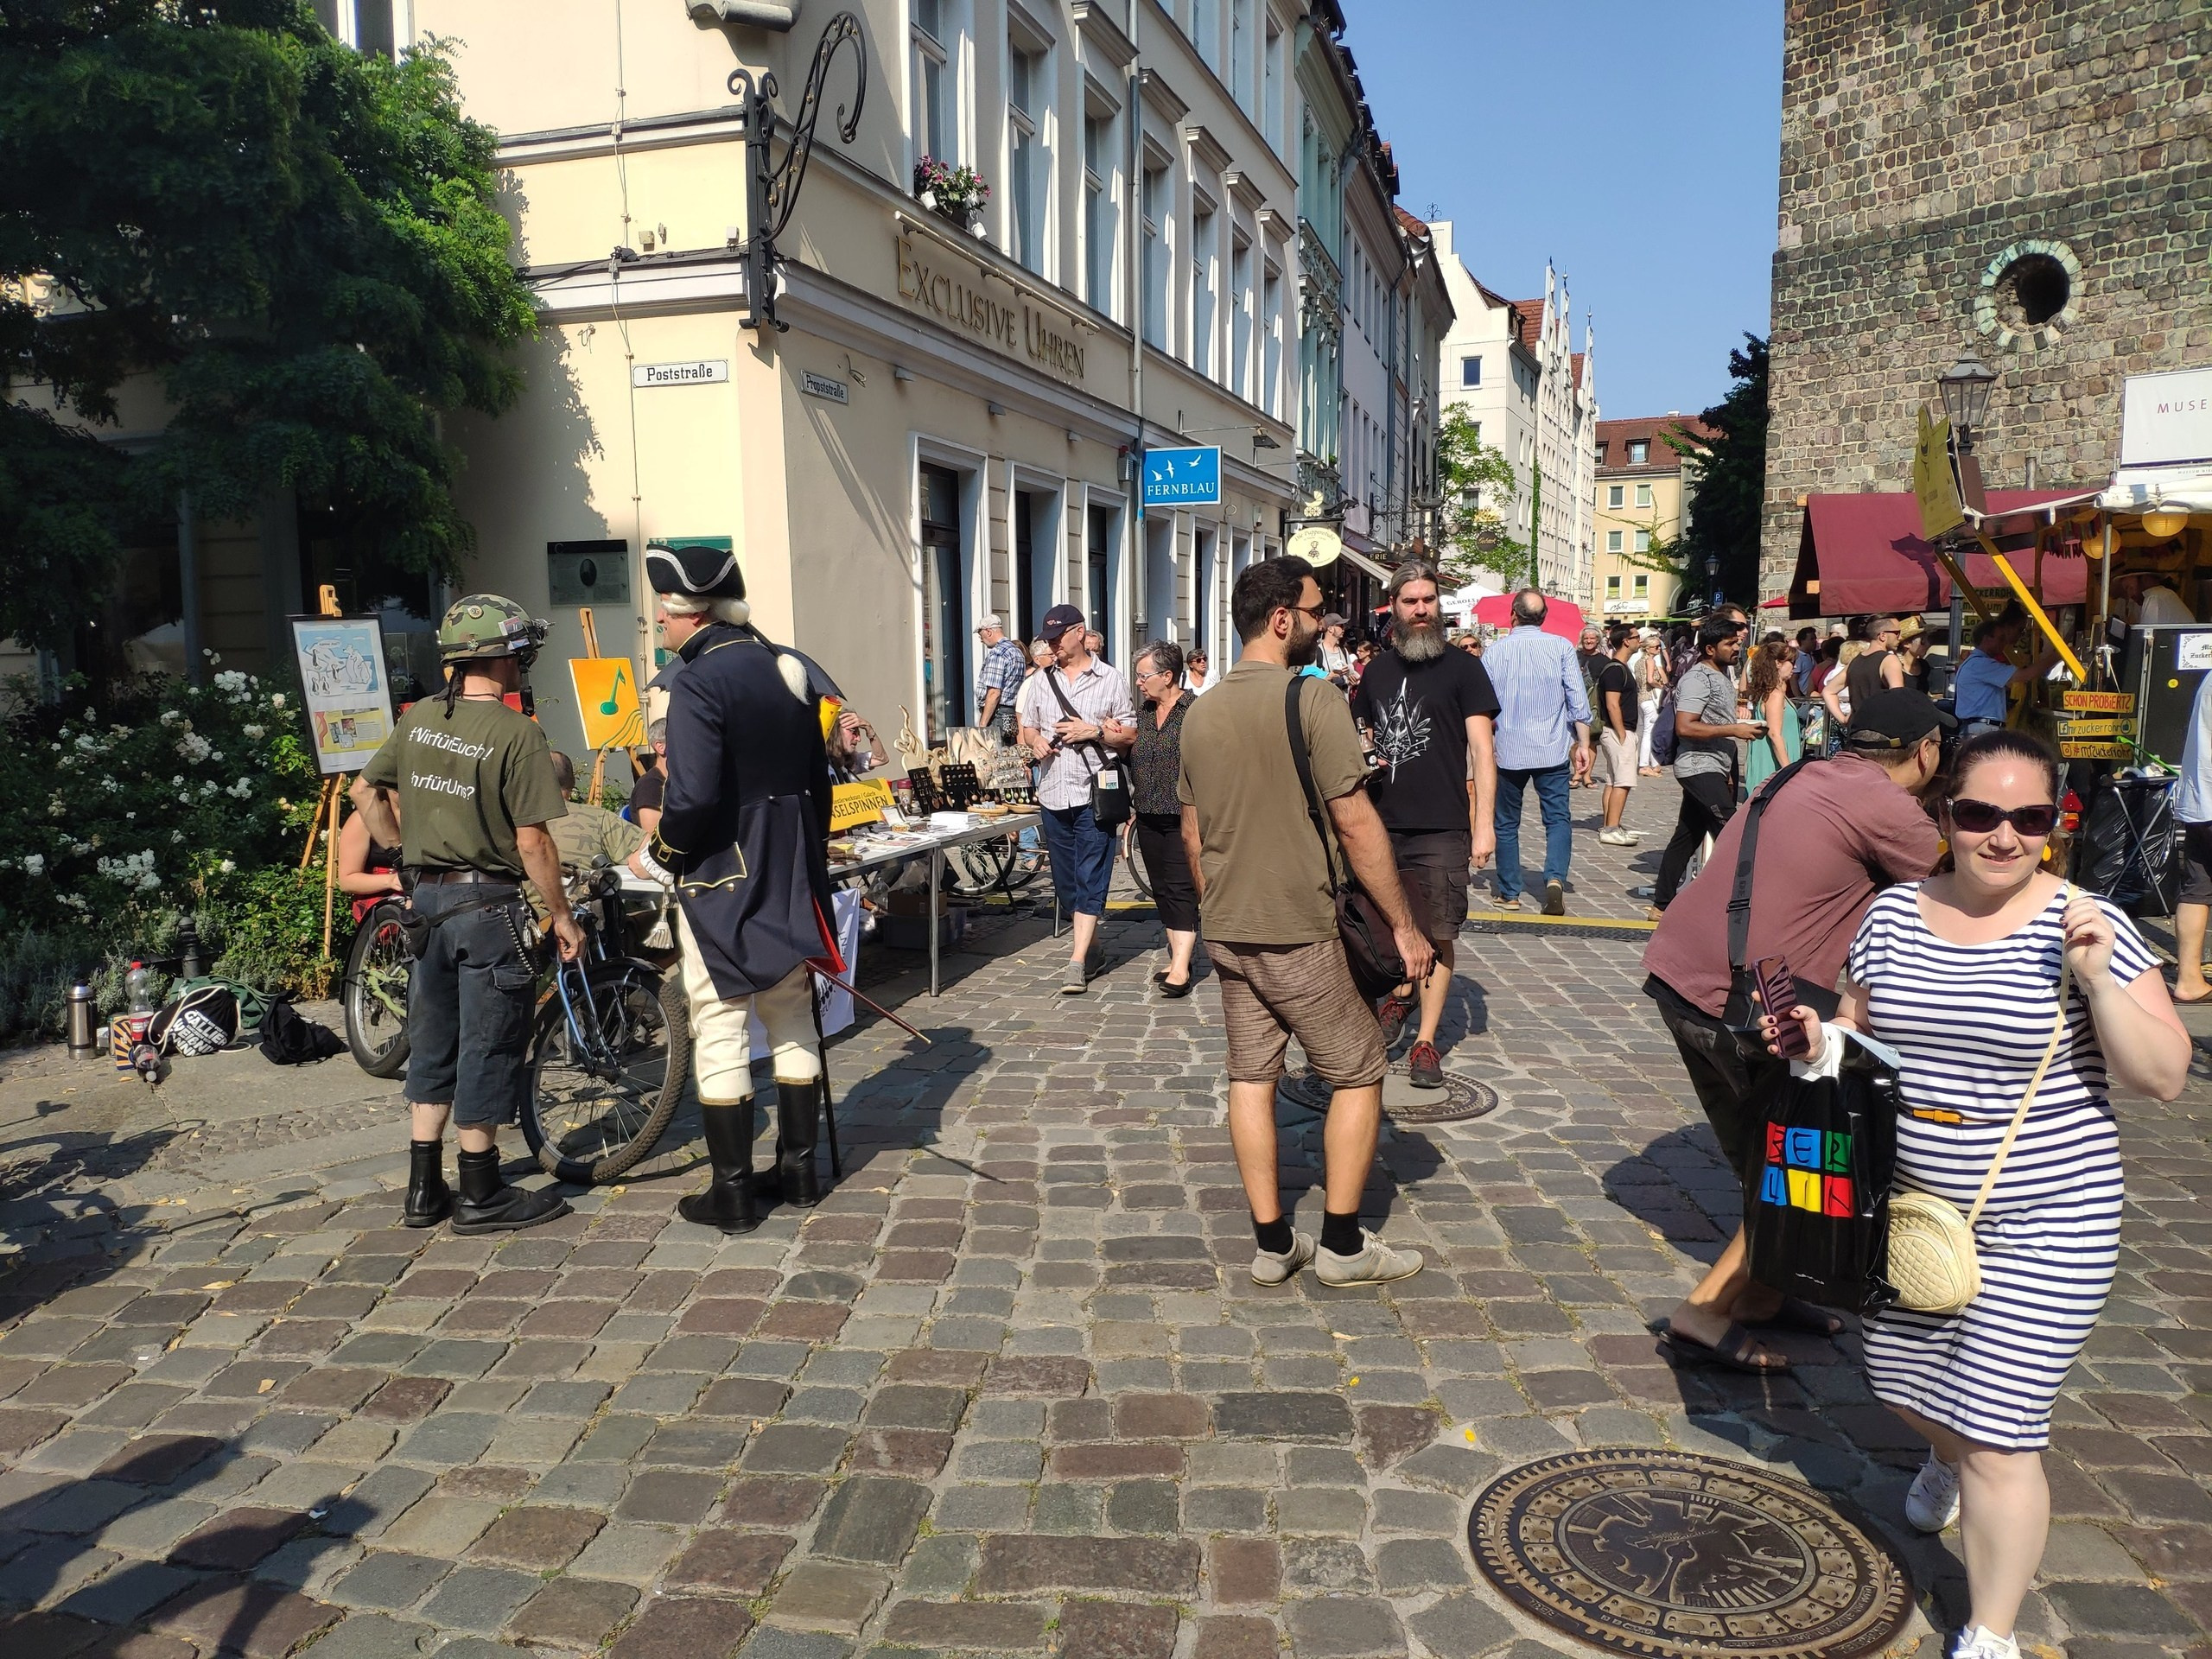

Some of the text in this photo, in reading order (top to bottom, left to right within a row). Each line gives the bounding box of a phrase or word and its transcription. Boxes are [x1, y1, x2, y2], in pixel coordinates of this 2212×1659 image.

[896, 236, 1085, 379] EXCLUSIVE UHREN
[646, 364, 714, 382] Poststraße
[806, 375, 844, 399] Propststraße
[2158, 398, 2208, 414] MUSE
[1147, 482, 1215, 496] FERNBLAU
